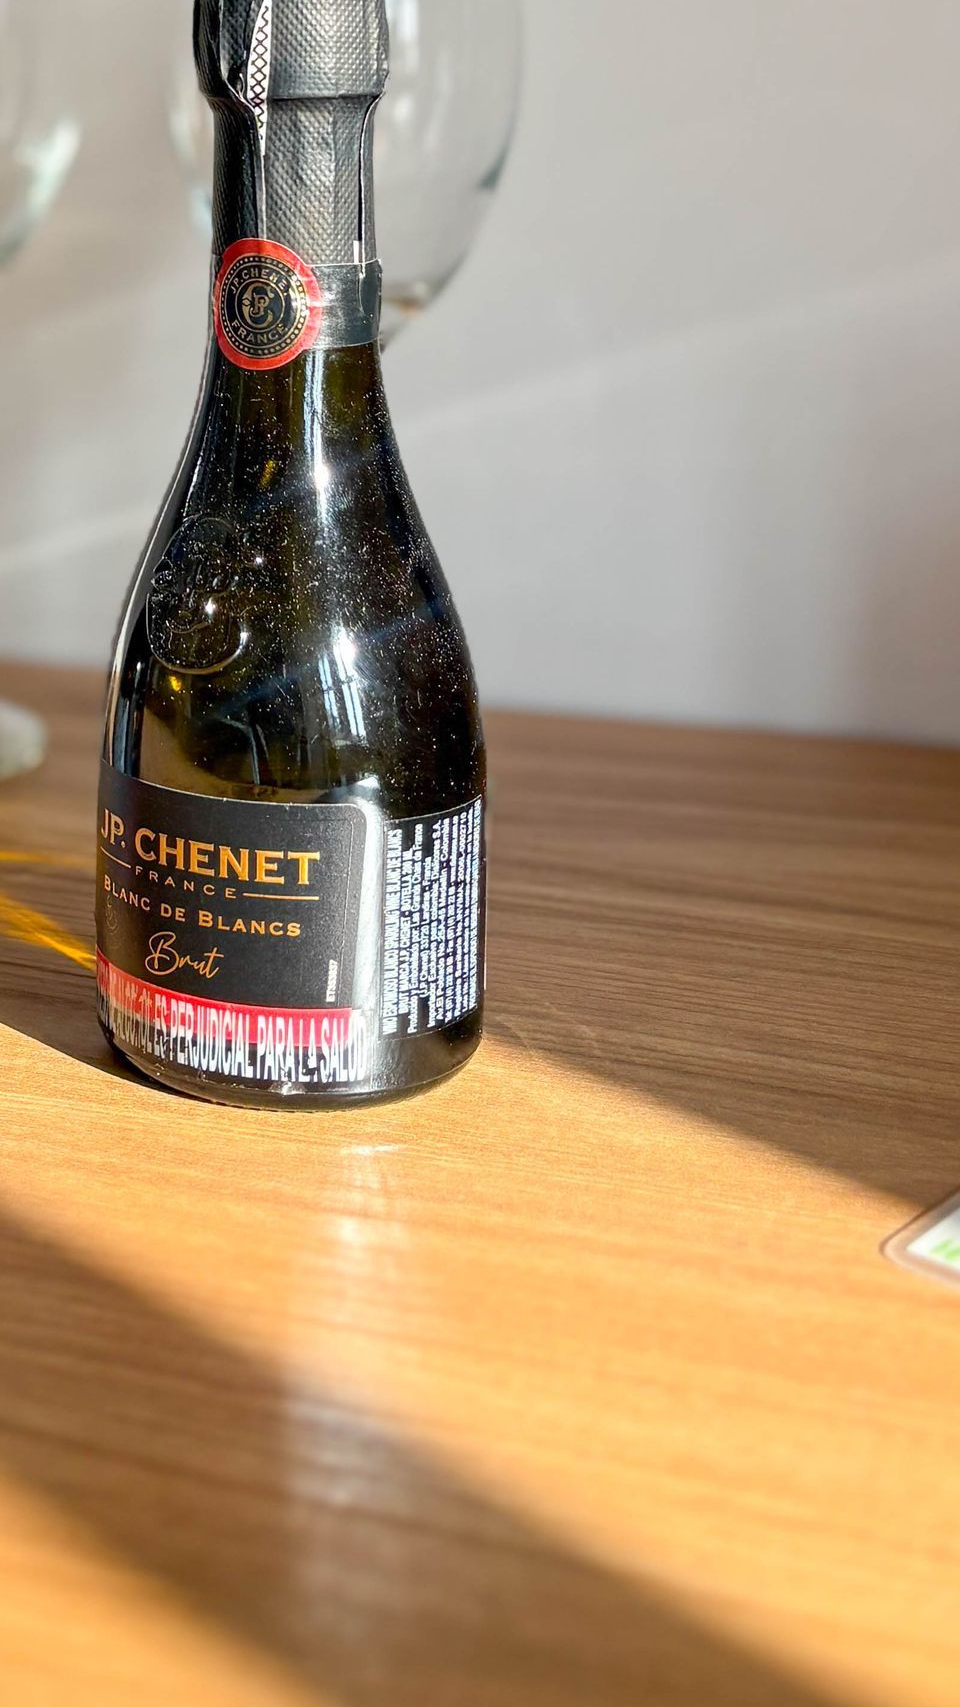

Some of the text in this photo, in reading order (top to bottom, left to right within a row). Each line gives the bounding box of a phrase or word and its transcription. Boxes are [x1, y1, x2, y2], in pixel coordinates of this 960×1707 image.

[241, 267, 290, 296] CHENE
[230, 319, 287, 344] FRANCE
[100, 809, 321, 886] JP. CHENET
[135, 865, 237, 899] FRANCE
[401, 875, 413, 911] BOTELLA
[104, 874, 302, 937] BLANC DE BLANCS
[144, 931, 225, 979] Brut
[154, 993, 167, 1059] ES
[169, 998, 254, 1079] PERJUDICIAL
[256, 1014, 296, 1083] PARA
[298, 1017, 318, 1083] LA
[319, 1012, 368, 1084] SALUD
